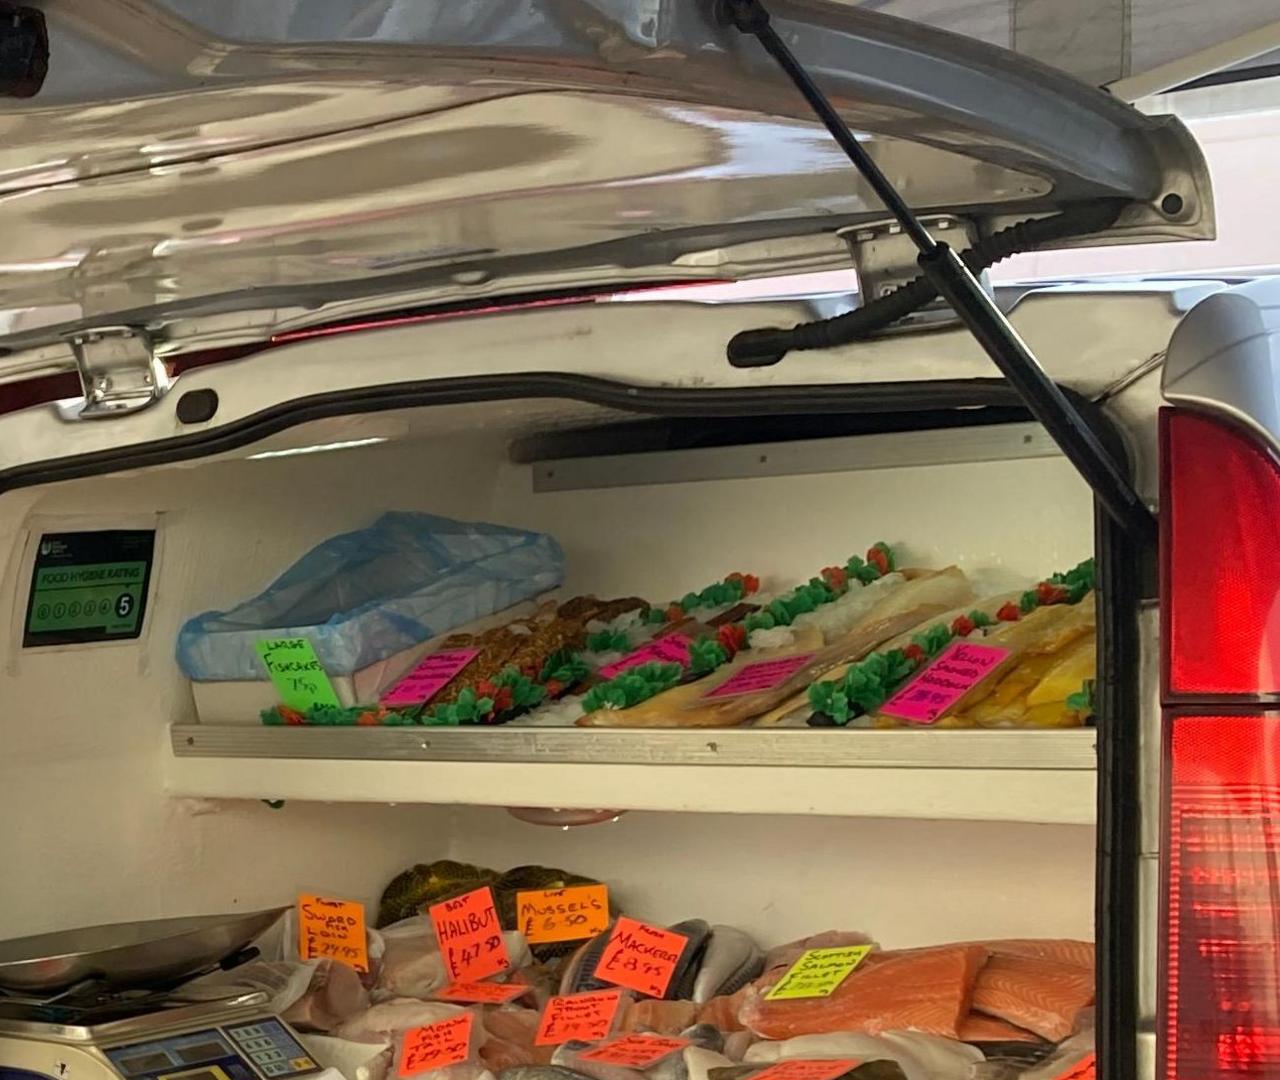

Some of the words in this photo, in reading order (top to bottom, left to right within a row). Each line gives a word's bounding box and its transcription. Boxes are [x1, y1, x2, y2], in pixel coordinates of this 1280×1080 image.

[41, 572, 70, 584] FOOD
[70, 569, 106, 582] HYGIENE
[107, 567, 141, 579] RATING
[118, 596, 130, 615] 5
[266, 638, 304, 650] LARGE
[436, 906, 494, 945] HALIBUT
